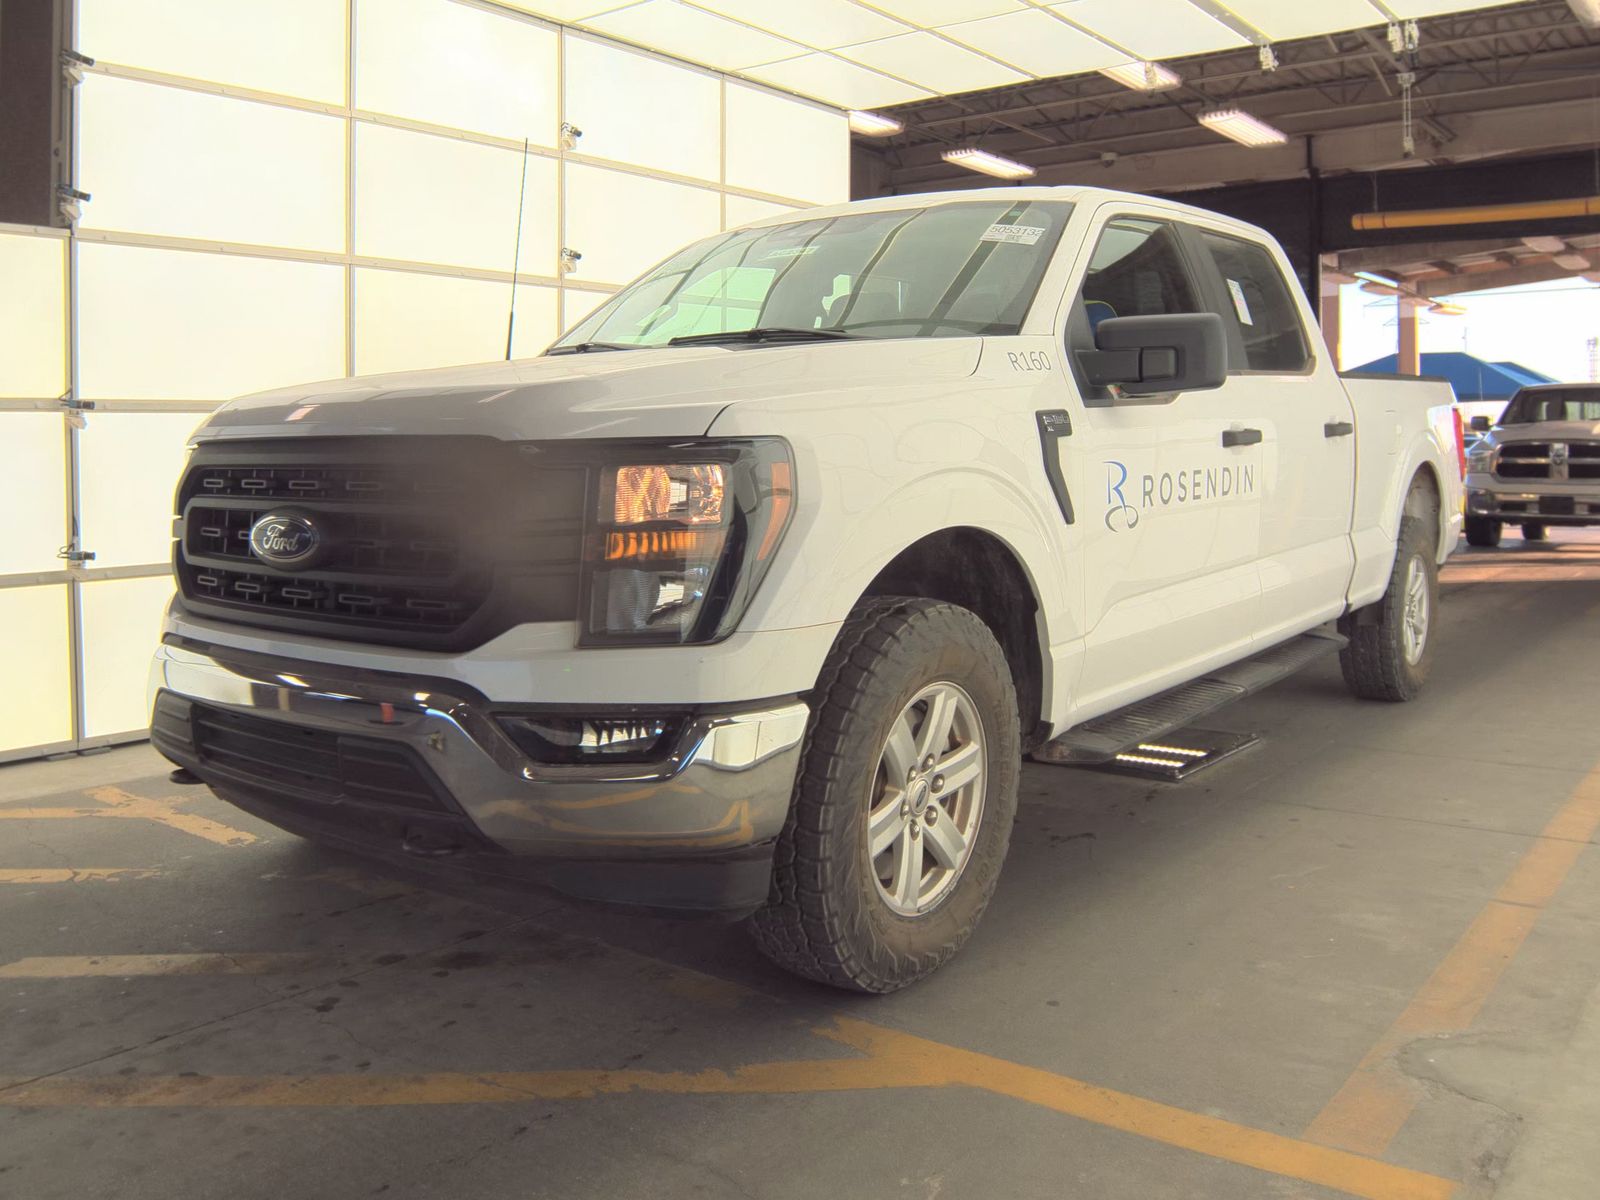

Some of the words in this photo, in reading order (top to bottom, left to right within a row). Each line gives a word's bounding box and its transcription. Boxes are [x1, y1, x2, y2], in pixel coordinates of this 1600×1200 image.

[1007, 351, 1052, 372] R160
[1142, 464, 1254, 508] ROSENDIN
[262, 523, 301, 552] Ford
